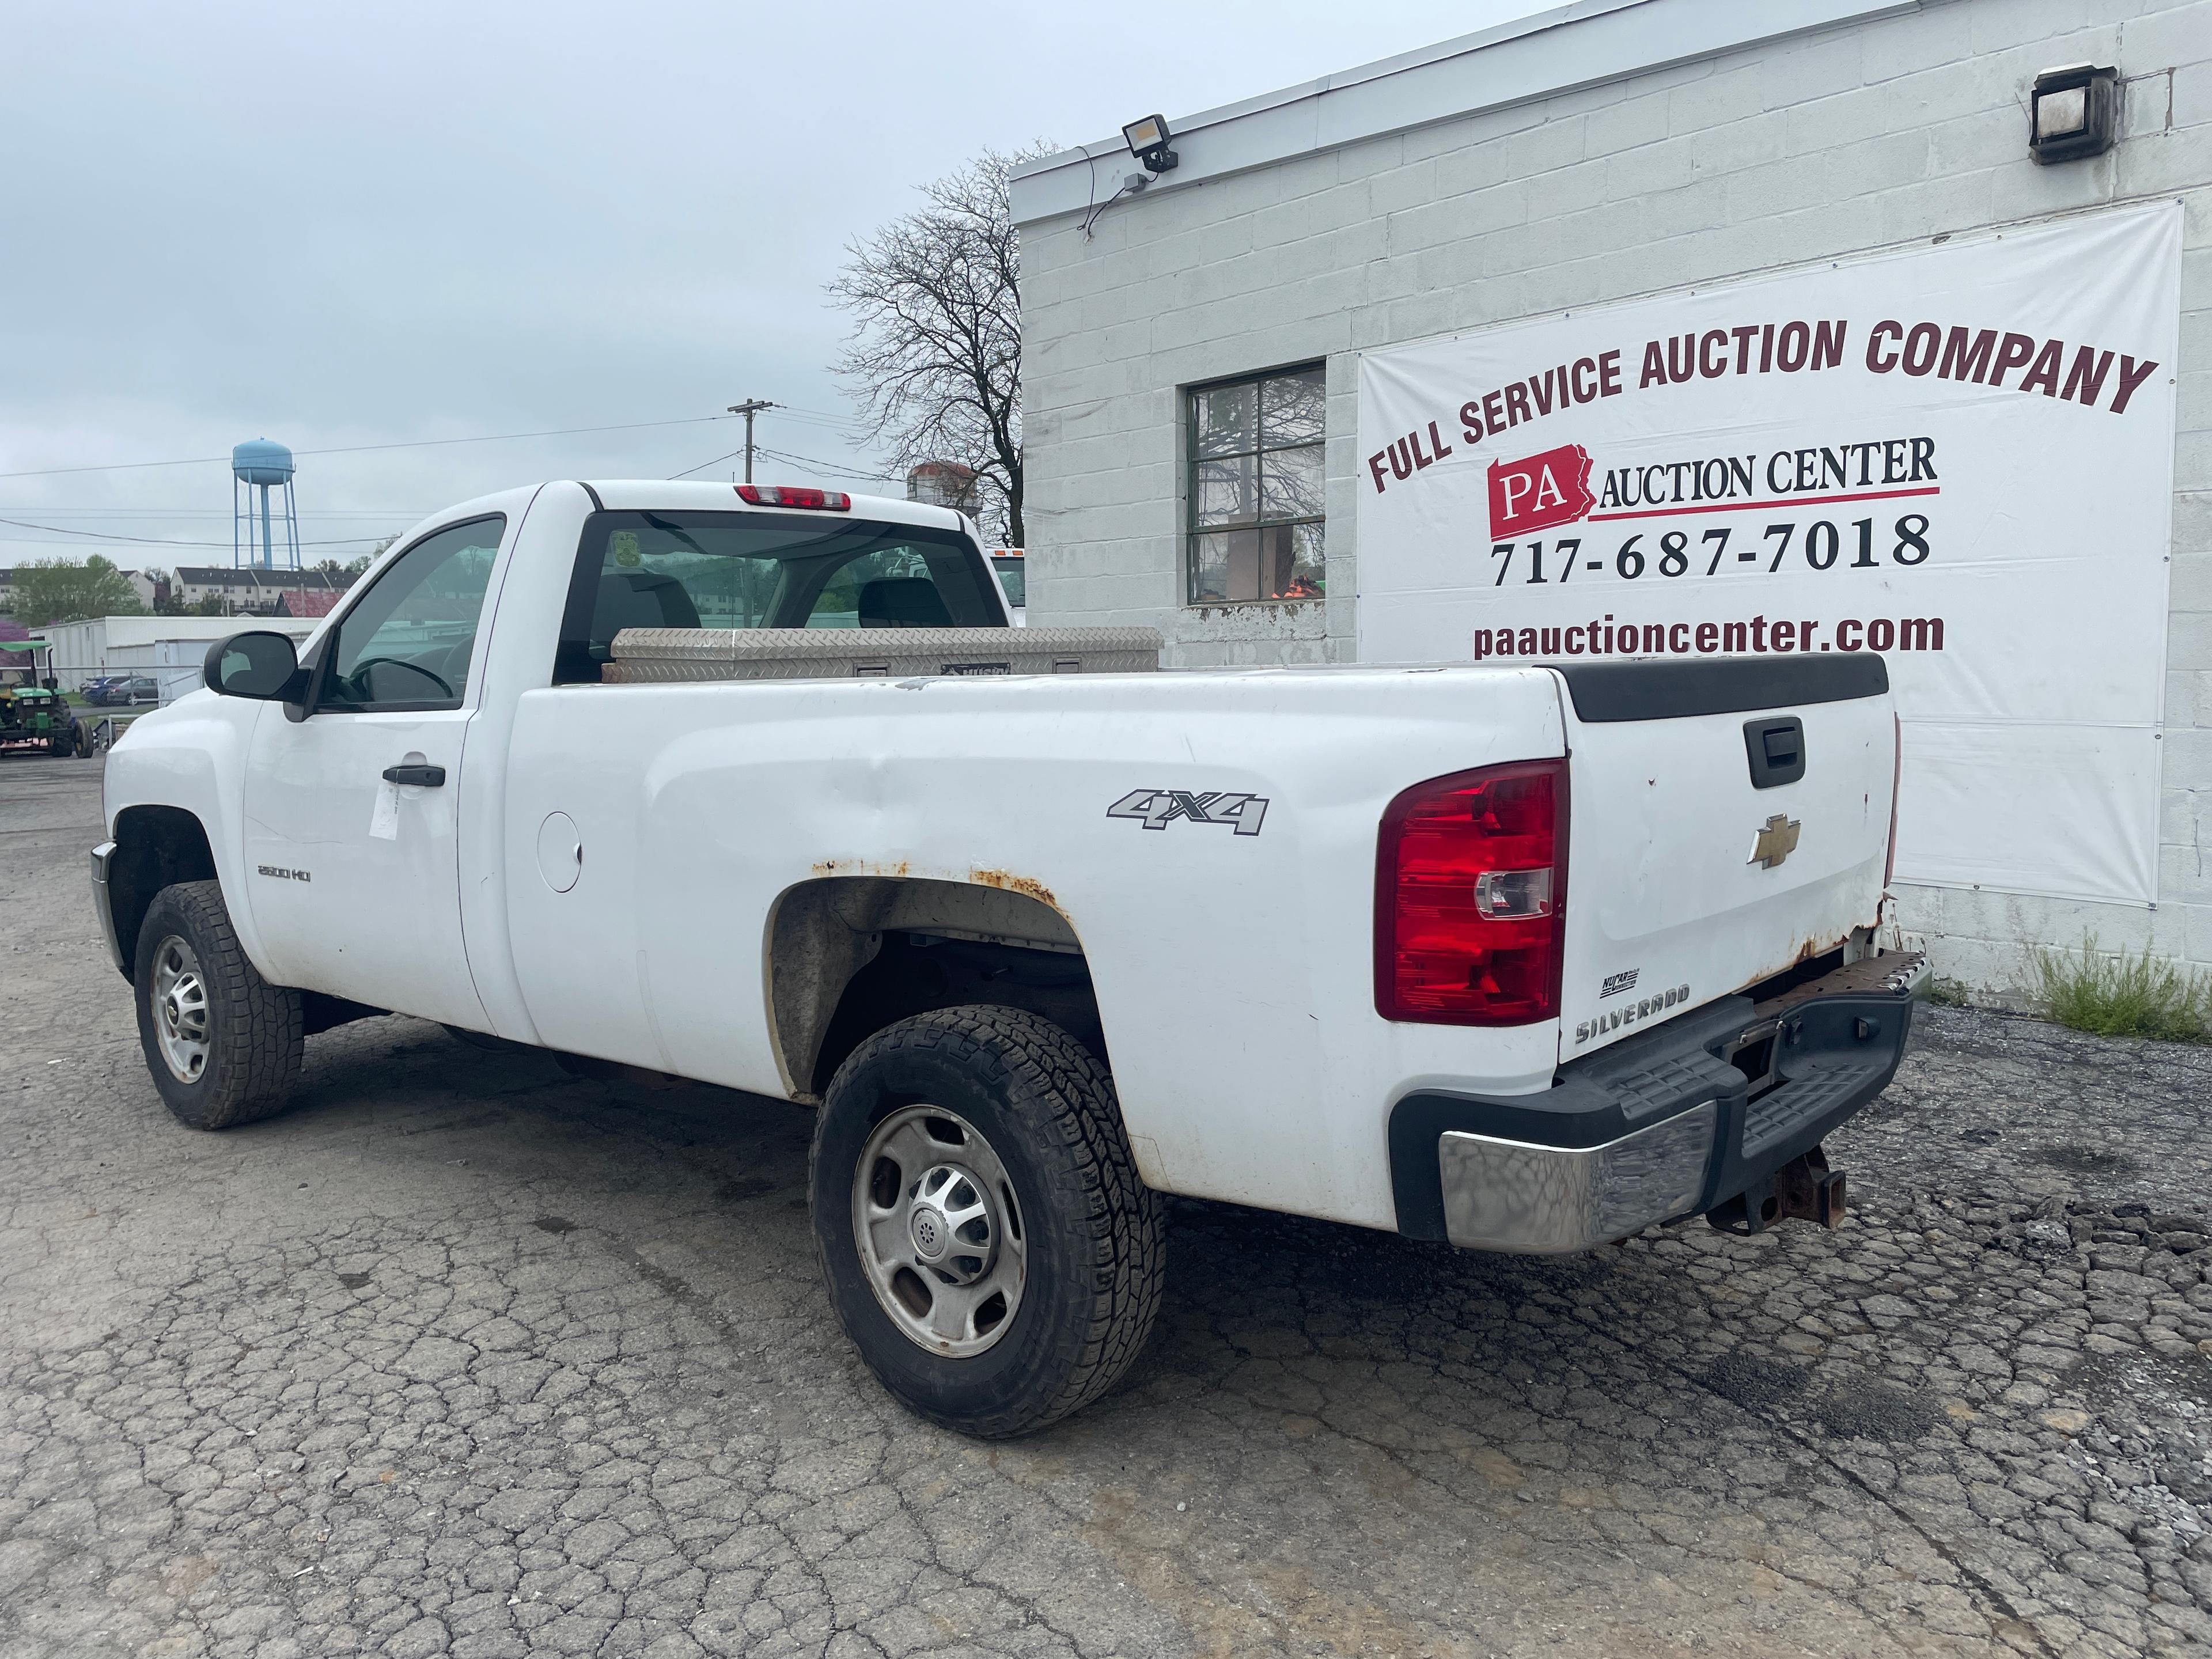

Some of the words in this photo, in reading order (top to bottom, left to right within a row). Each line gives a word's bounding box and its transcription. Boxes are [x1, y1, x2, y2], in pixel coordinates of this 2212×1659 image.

[1368, 420, 1452, 494] FULL
[1459, 349, 1622, 444] SERVICE
[1639, 320, 1847, 389] AUCTION
[1866, 320, 2160, 415] COMPANY
[1499, 464, 1567, 521] PA
[1599, 454, 1756, 509] AUCTION
[1767, 437, 1938, 494] CENTER
[1491, 514, 1930, 586] 717-687-7018
[1474, 614, 1944, 661] paauctioncenter.com
[291, 869, 310, 882] HD
[1575, 983, 1690, 1044] SILVERADO
